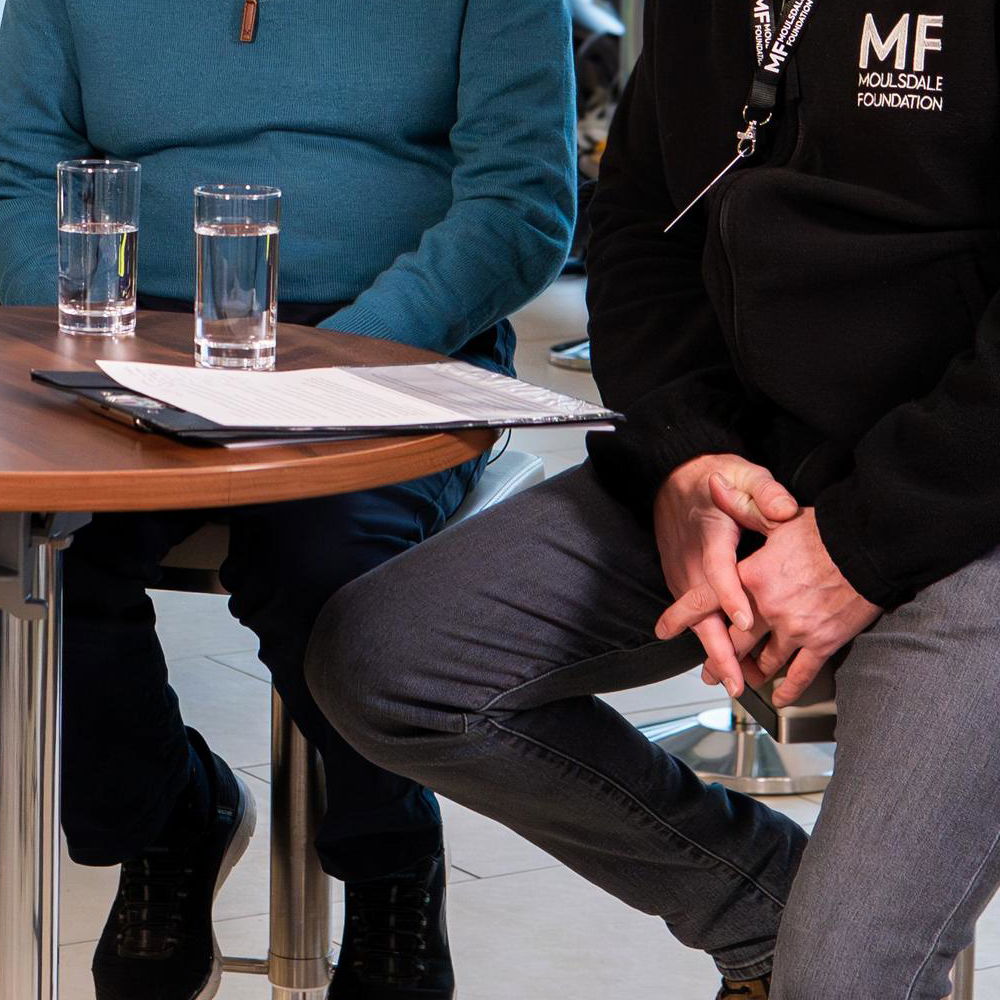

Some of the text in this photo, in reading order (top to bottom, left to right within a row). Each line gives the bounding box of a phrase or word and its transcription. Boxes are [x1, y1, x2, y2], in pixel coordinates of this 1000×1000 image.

[858, 12, 944, 72] MF
[764, 40, 789, 74] MF
[858, 71, 944, 92] MOULSDALE
[857, 91, 944, 112] FOUNDATION
